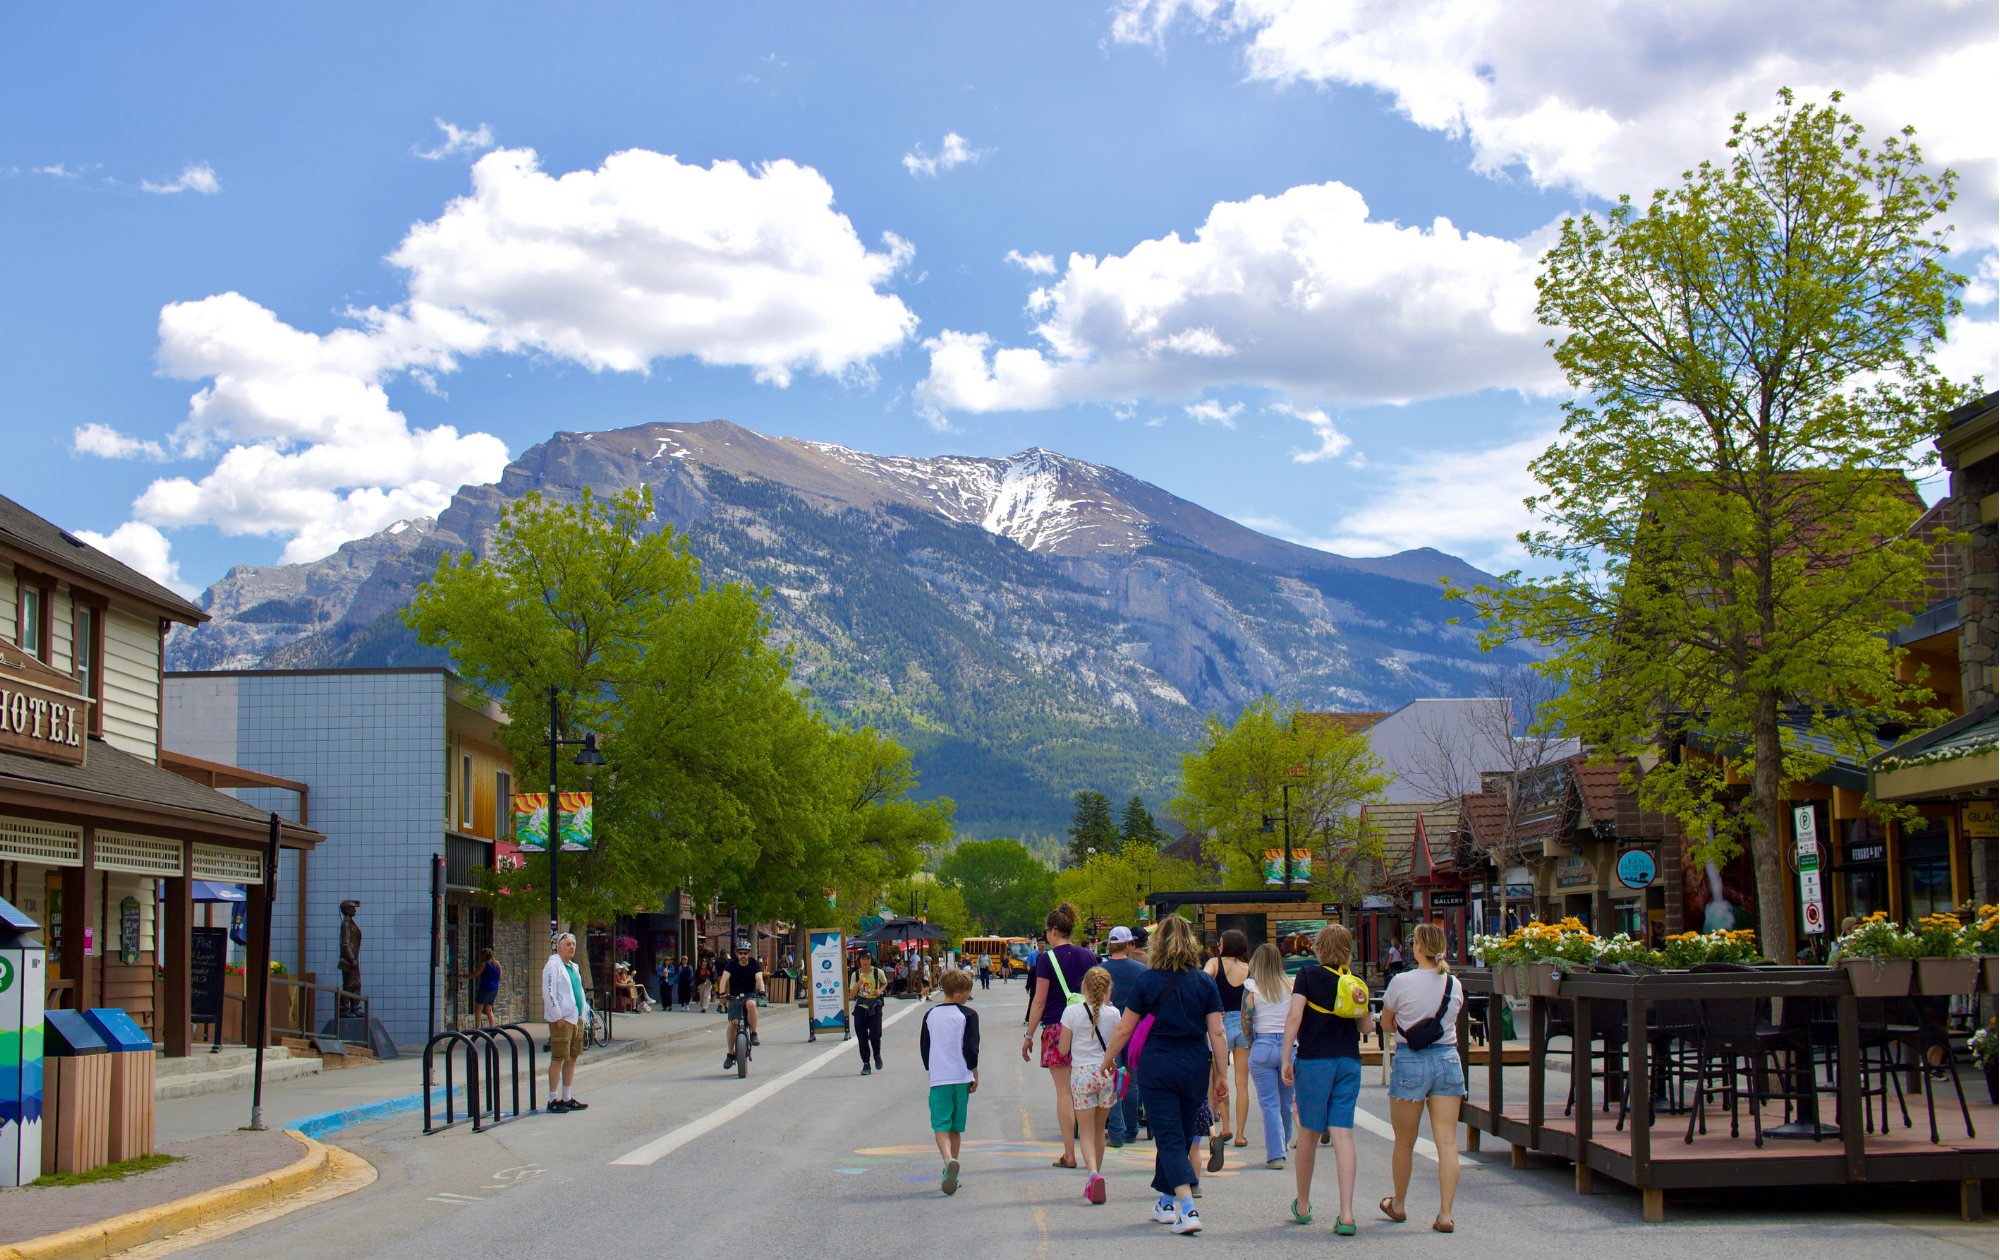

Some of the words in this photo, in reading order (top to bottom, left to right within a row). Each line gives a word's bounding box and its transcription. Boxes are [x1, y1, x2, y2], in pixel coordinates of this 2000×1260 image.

[0, 688, 80, 747] HOTEL
[1852, 848, 1870, 860] FERGUS
[1621, 863, 1653, 871] HOEHN
[24, 899, 37, 913] 738
